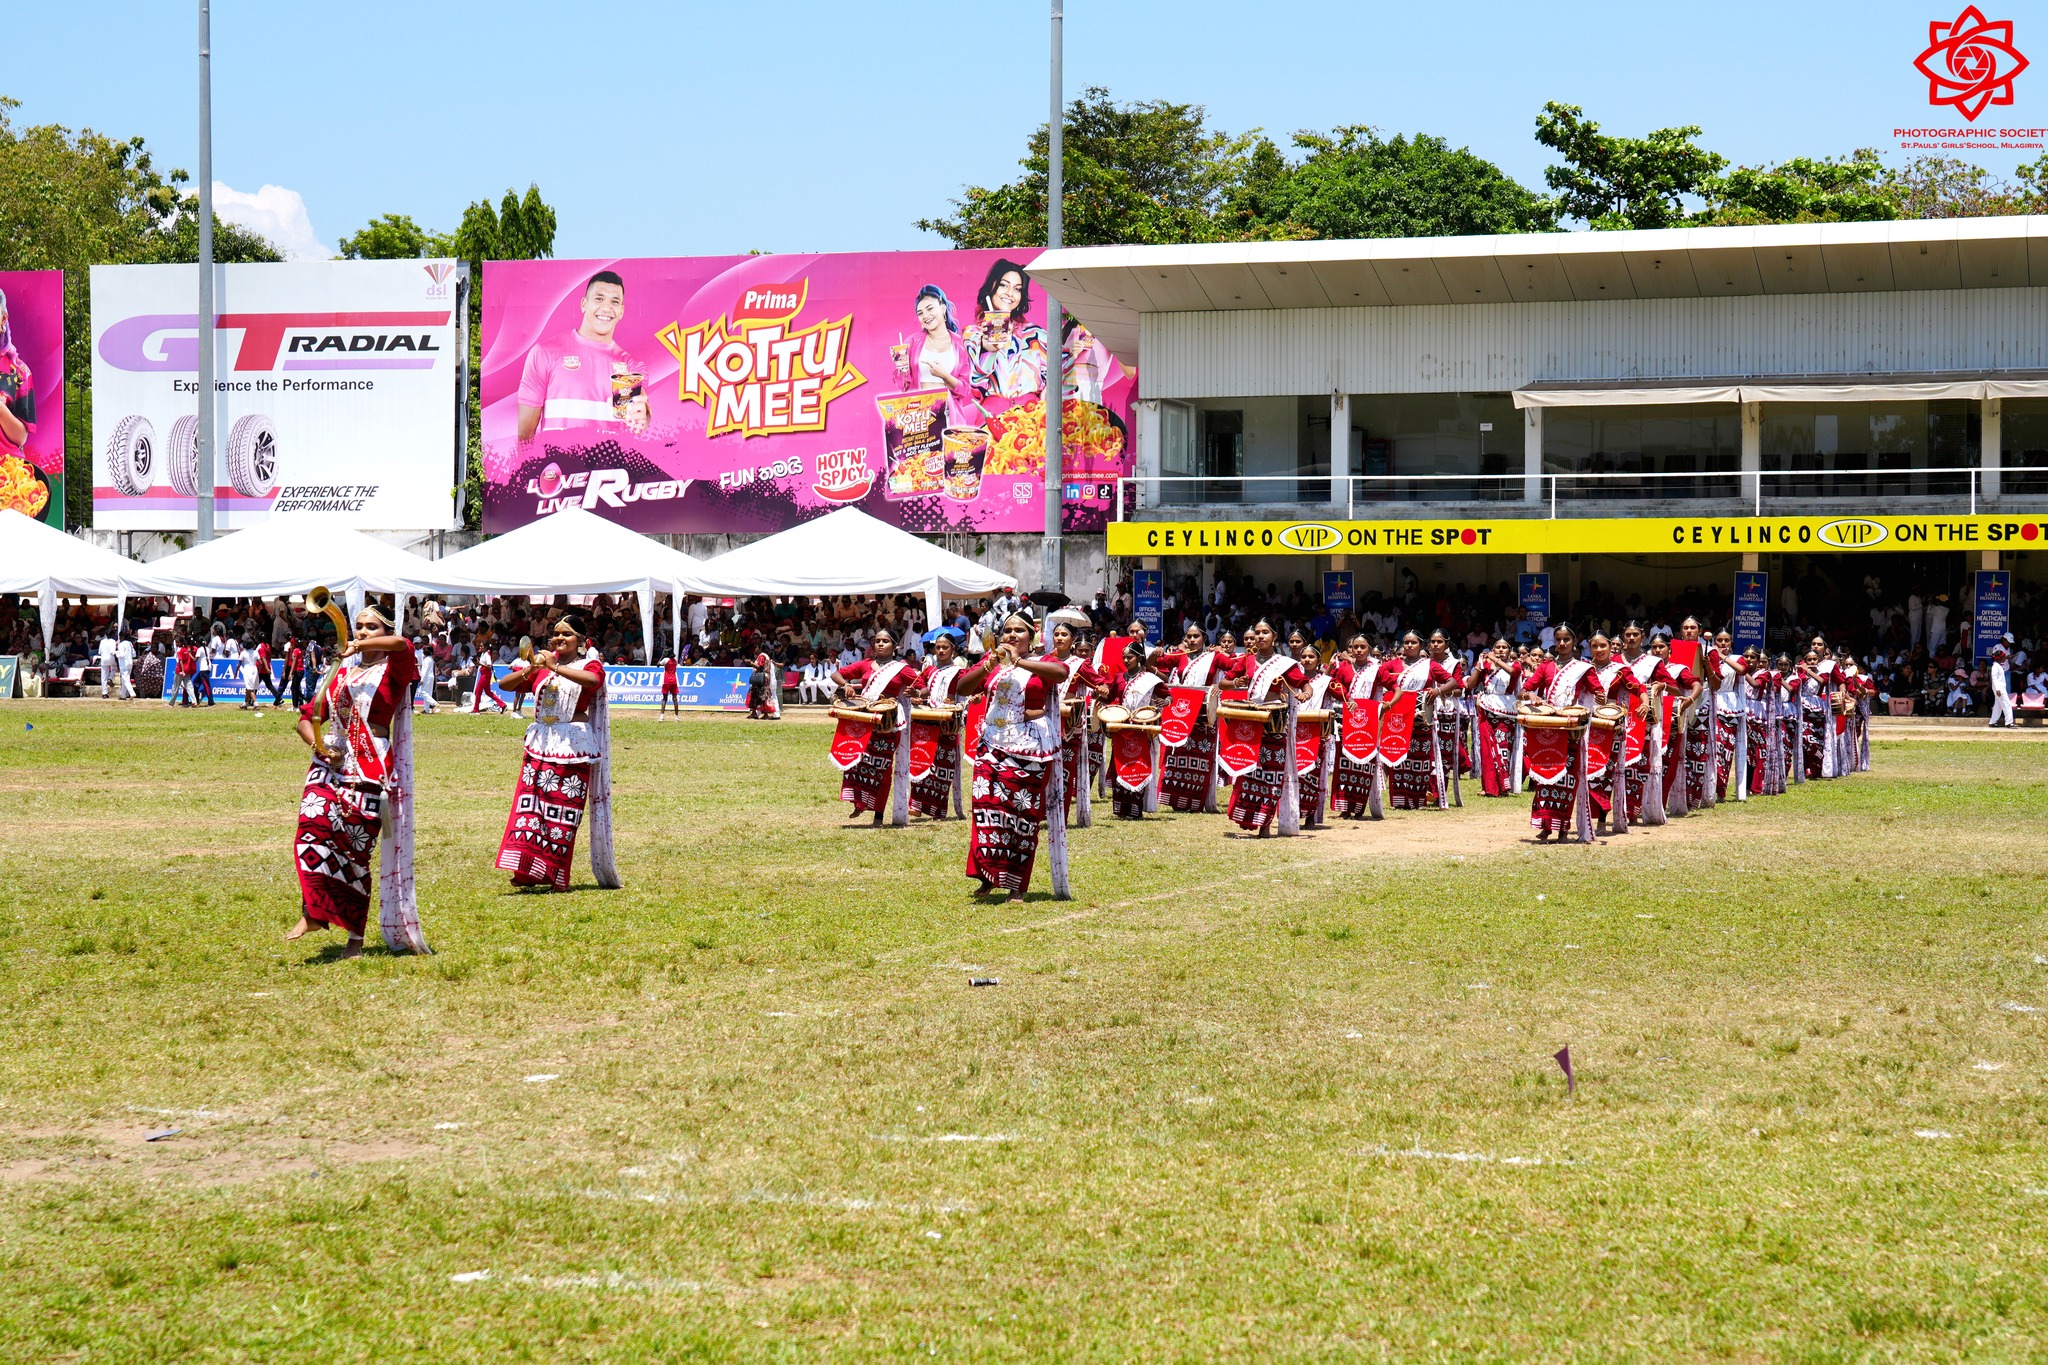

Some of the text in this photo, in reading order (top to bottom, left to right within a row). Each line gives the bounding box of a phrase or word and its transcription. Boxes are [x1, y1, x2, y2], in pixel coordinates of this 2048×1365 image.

[427, 284, 447, 296] dsl
[743, 290, 798, 310] Prima
[288, 335, 440, 352] RADIAL
[684, 324, 846, 396] KOTTU
[174, 378, 374, 394] Expience the Performance
[713, 377, 822, 429] MEE
[905, 420, 927, 433] MEE
[817, 452, 845, 472] HOT
[719, 467, 755, 489] FUN
[820, 465, 866, 487] SPICY
[281, 486, 379, 498] EXPERIENCE THE
[582, 468, 695, 509] RUGBY
[275, 499, 365, 512] PERFORMANCE
[536, 495, 583, 515] LIVE
[1147, 528, 1491, 547] CEYLINCO VIP ON THE SPOT
[1672, 525, 1811, 544] CEYLINCO
[1835, 525, 1872, 543] VIP
[1895, 524, 1927, 541] ON
[1934, 523, 1978, 541] THE
[212, 687, 237, 696] OFFICIAL
[622, 694, 655, 702] HAVELOCK
[681, 695, 698, 703] CLUB
